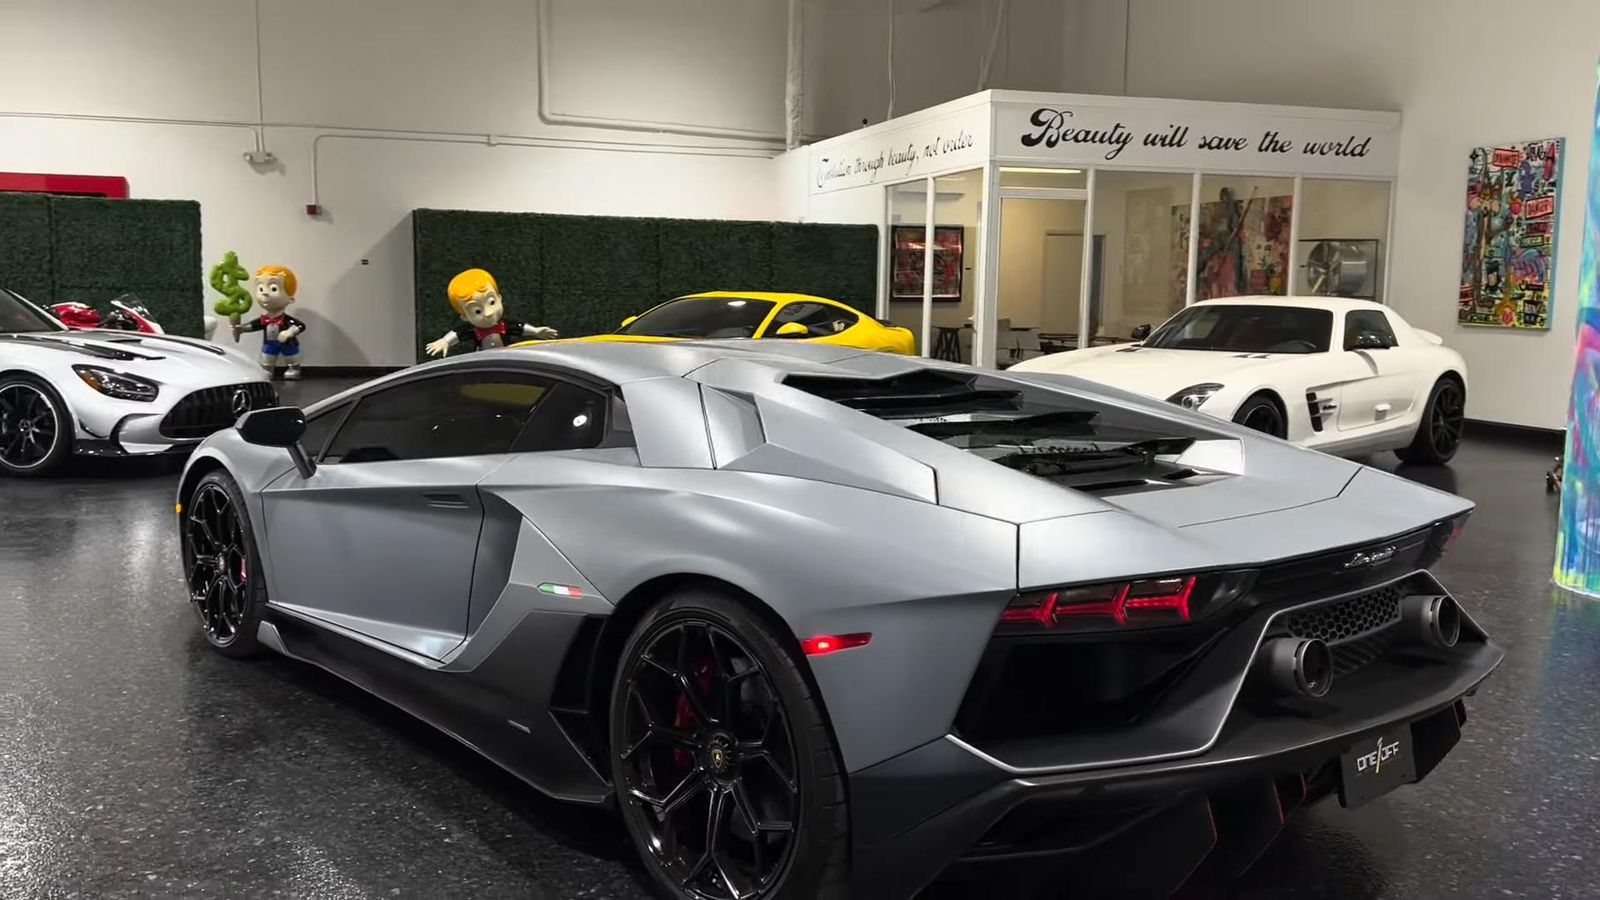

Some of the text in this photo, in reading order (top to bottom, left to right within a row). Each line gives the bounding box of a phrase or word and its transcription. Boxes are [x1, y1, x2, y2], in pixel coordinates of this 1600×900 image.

[924, 136, 940, 158] not
[1021, 107, 1372, 160] Beauty will save the world
